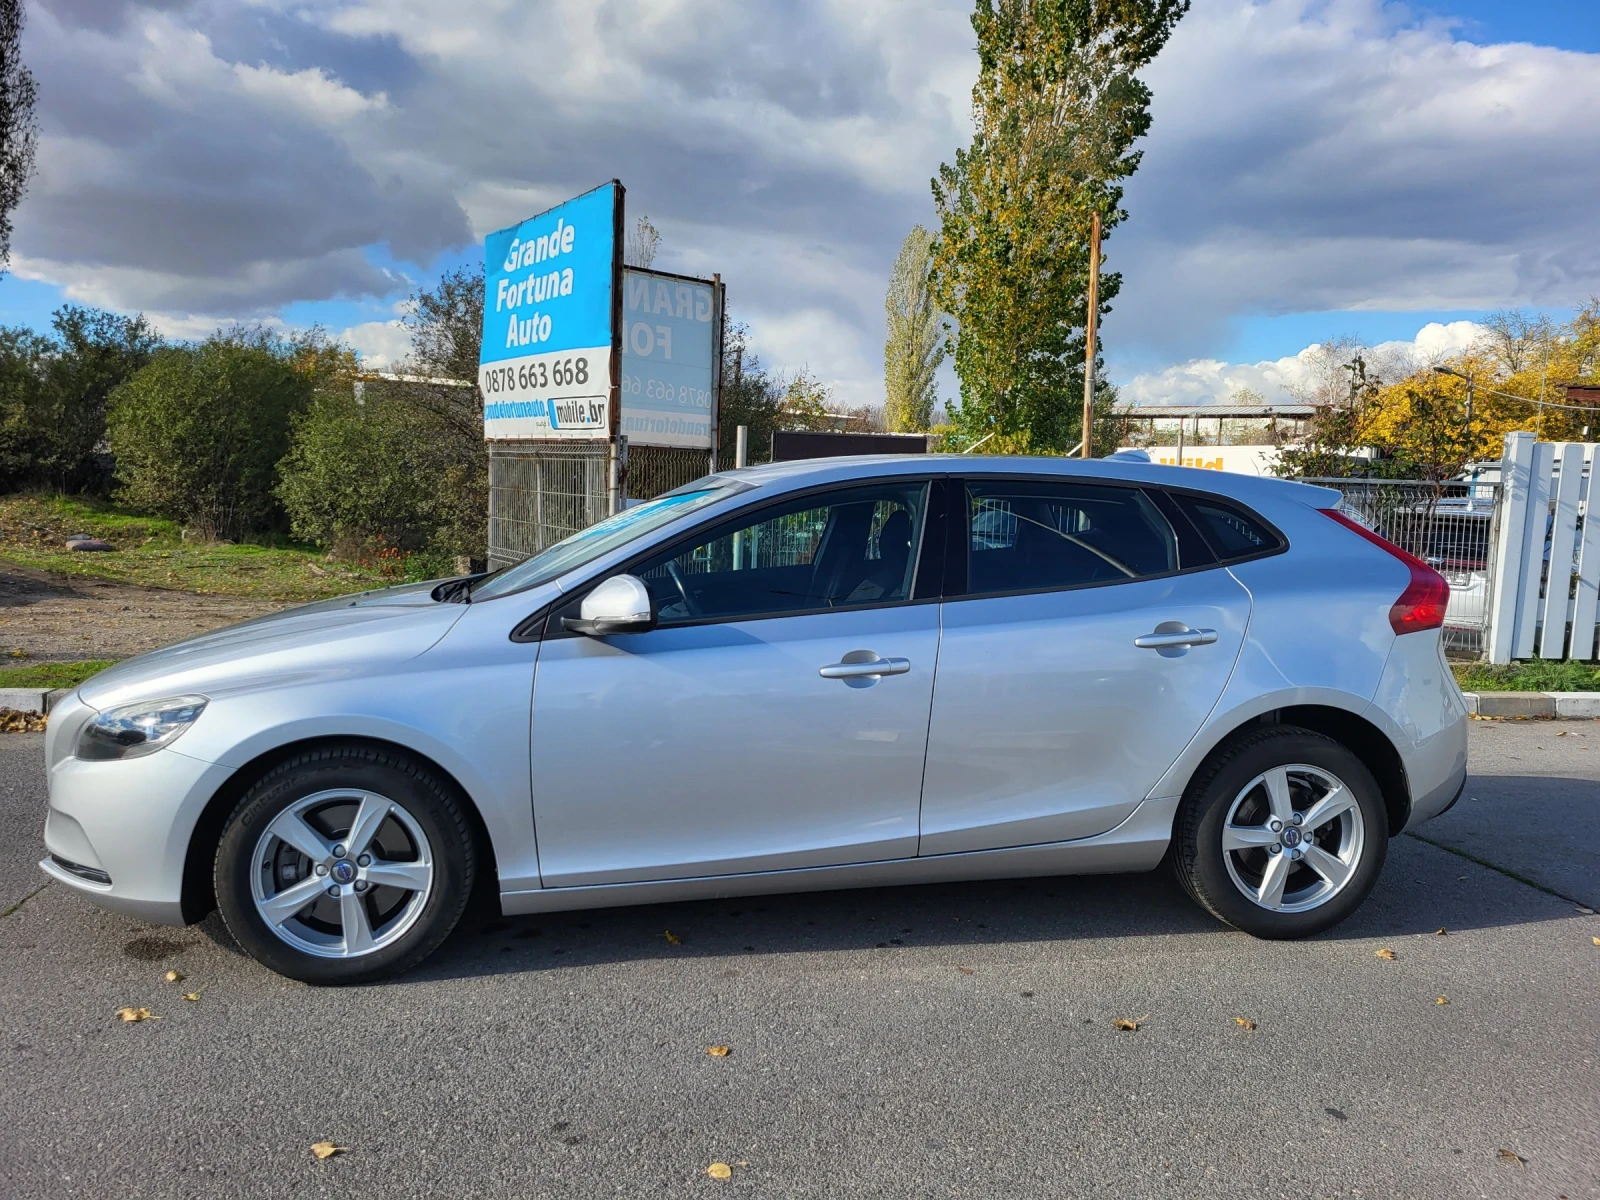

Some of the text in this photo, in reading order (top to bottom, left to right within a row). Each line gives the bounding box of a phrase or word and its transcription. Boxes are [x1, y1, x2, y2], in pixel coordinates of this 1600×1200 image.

[503, 217, 575, 273] Grande
[496, 267, 574, 313] Fortuna
[505, 311, 552, 349] Auto
[485, 357, 589, 394] 0878 663 668
